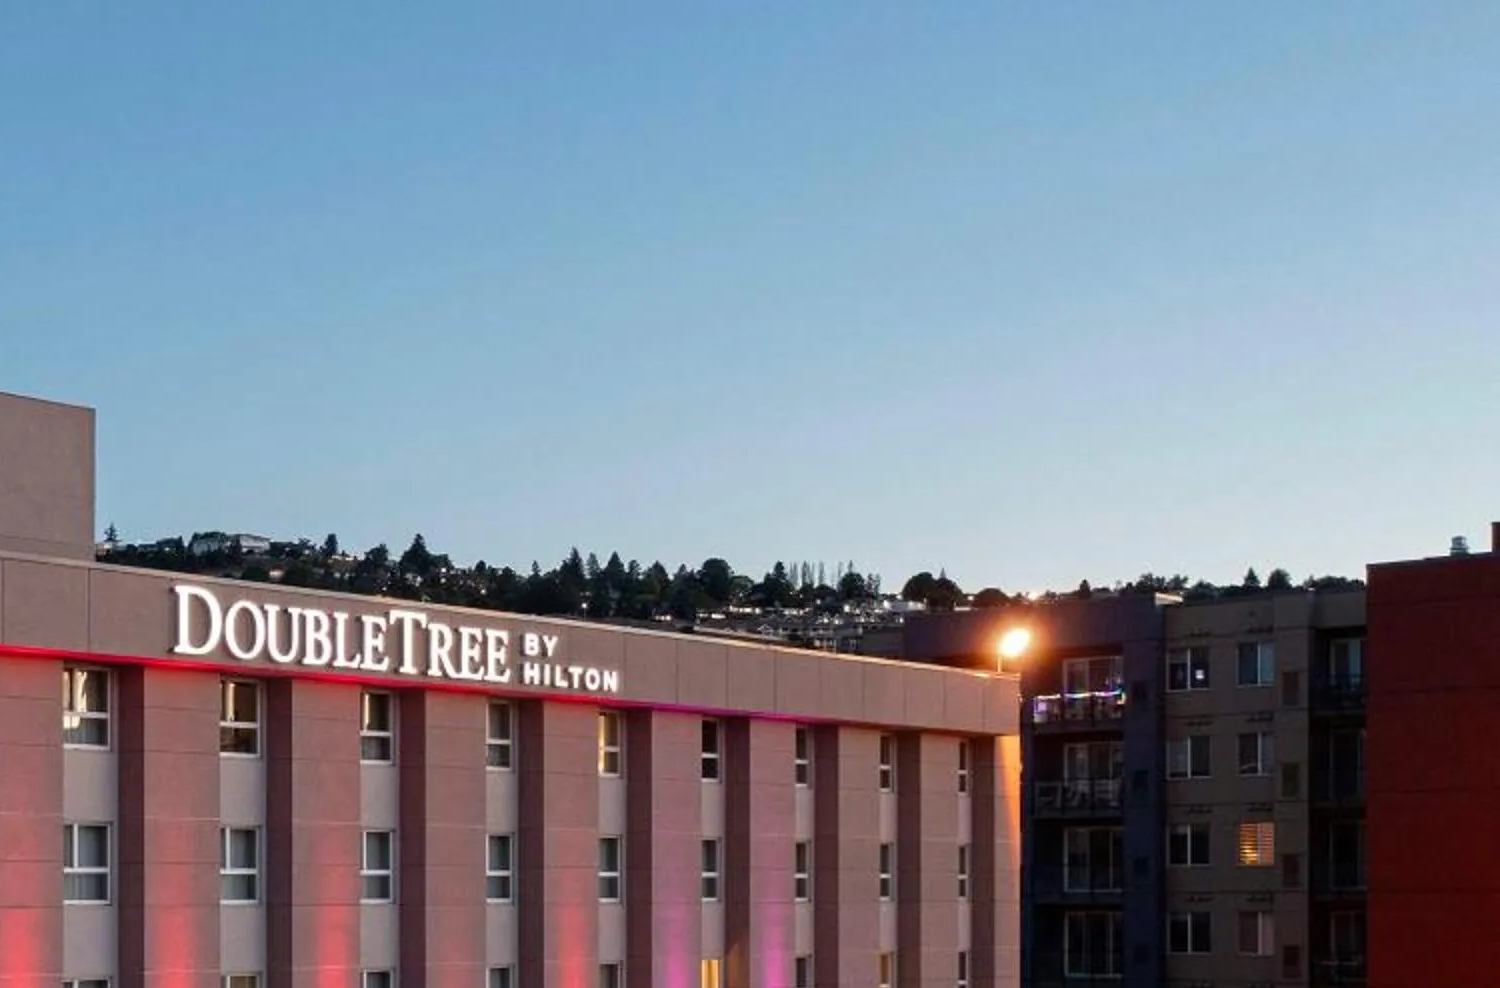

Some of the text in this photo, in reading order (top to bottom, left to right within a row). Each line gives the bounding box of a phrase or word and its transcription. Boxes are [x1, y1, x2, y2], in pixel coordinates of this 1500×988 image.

[173, 584, 511, 684] DOUBLETREE
[523, 632, 558, 657] BY
[523, 661, 619, 693] HILTON
